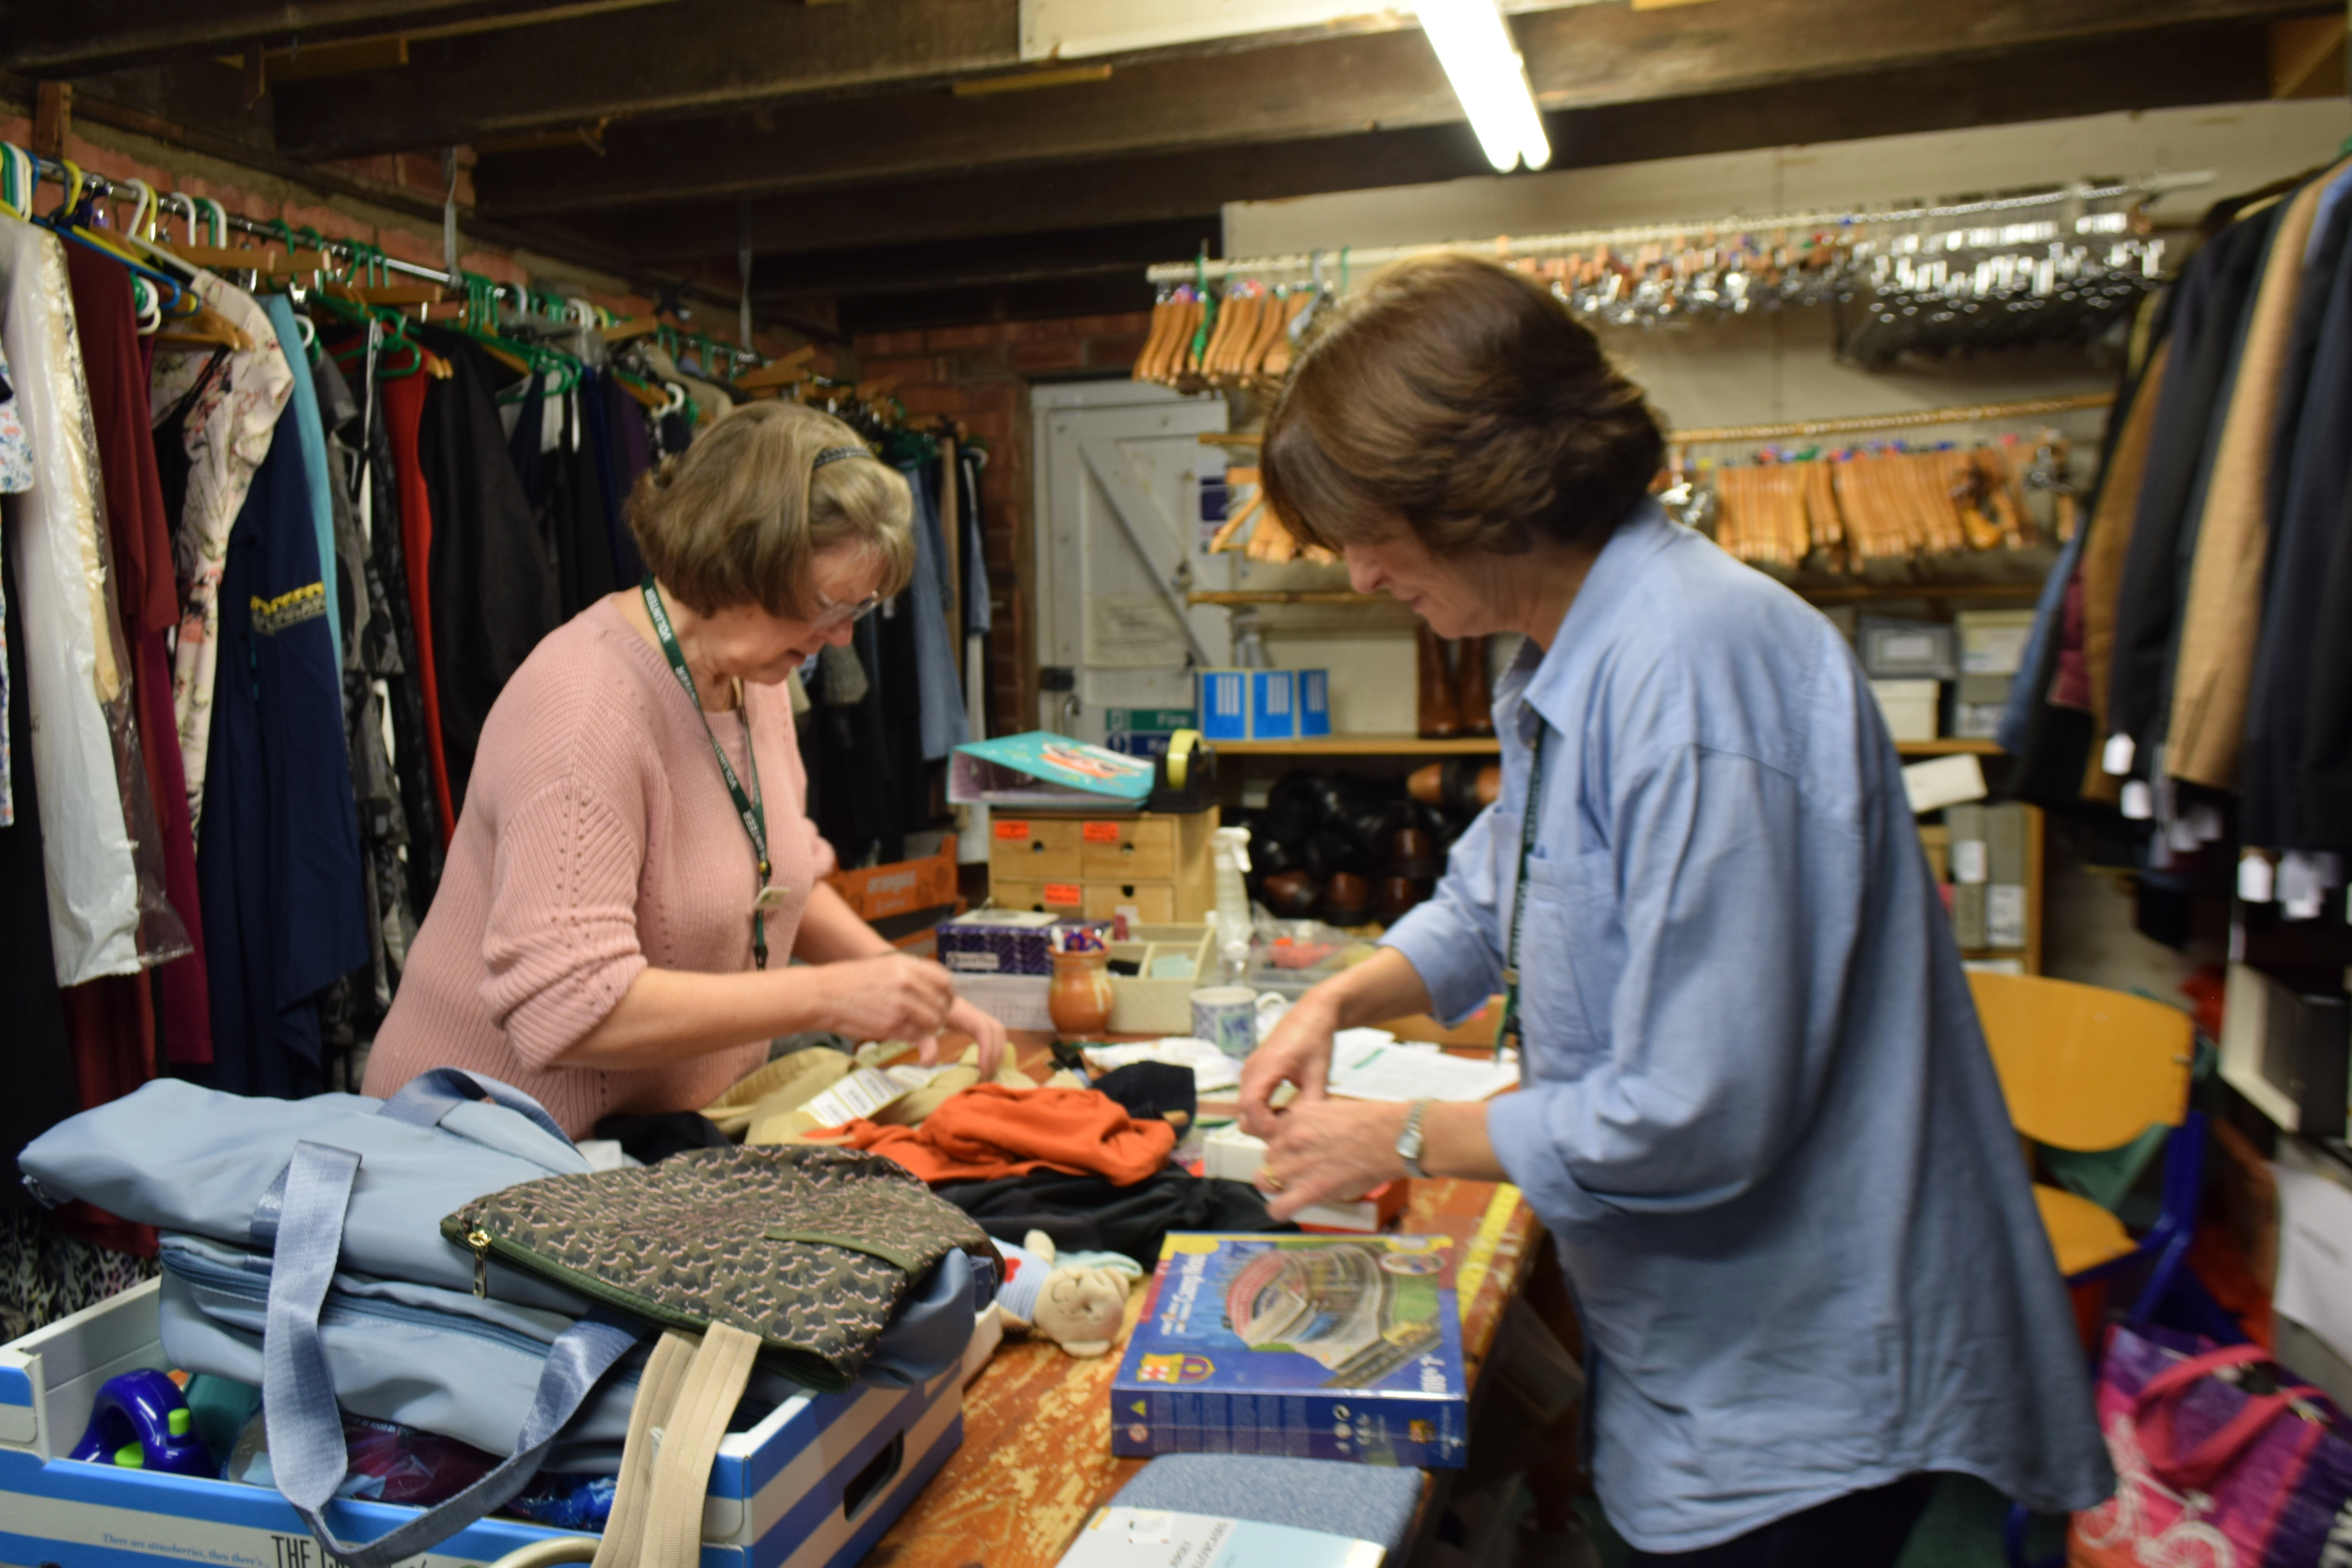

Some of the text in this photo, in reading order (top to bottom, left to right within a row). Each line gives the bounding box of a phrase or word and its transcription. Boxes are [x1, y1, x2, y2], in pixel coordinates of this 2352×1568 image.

[644, 586, 673, 643] VOLUNTEER
[103, 1532, 127, 1546] There
[209, 1549, 229, 1562] then
[271, 1535, 312, 1568] THE
